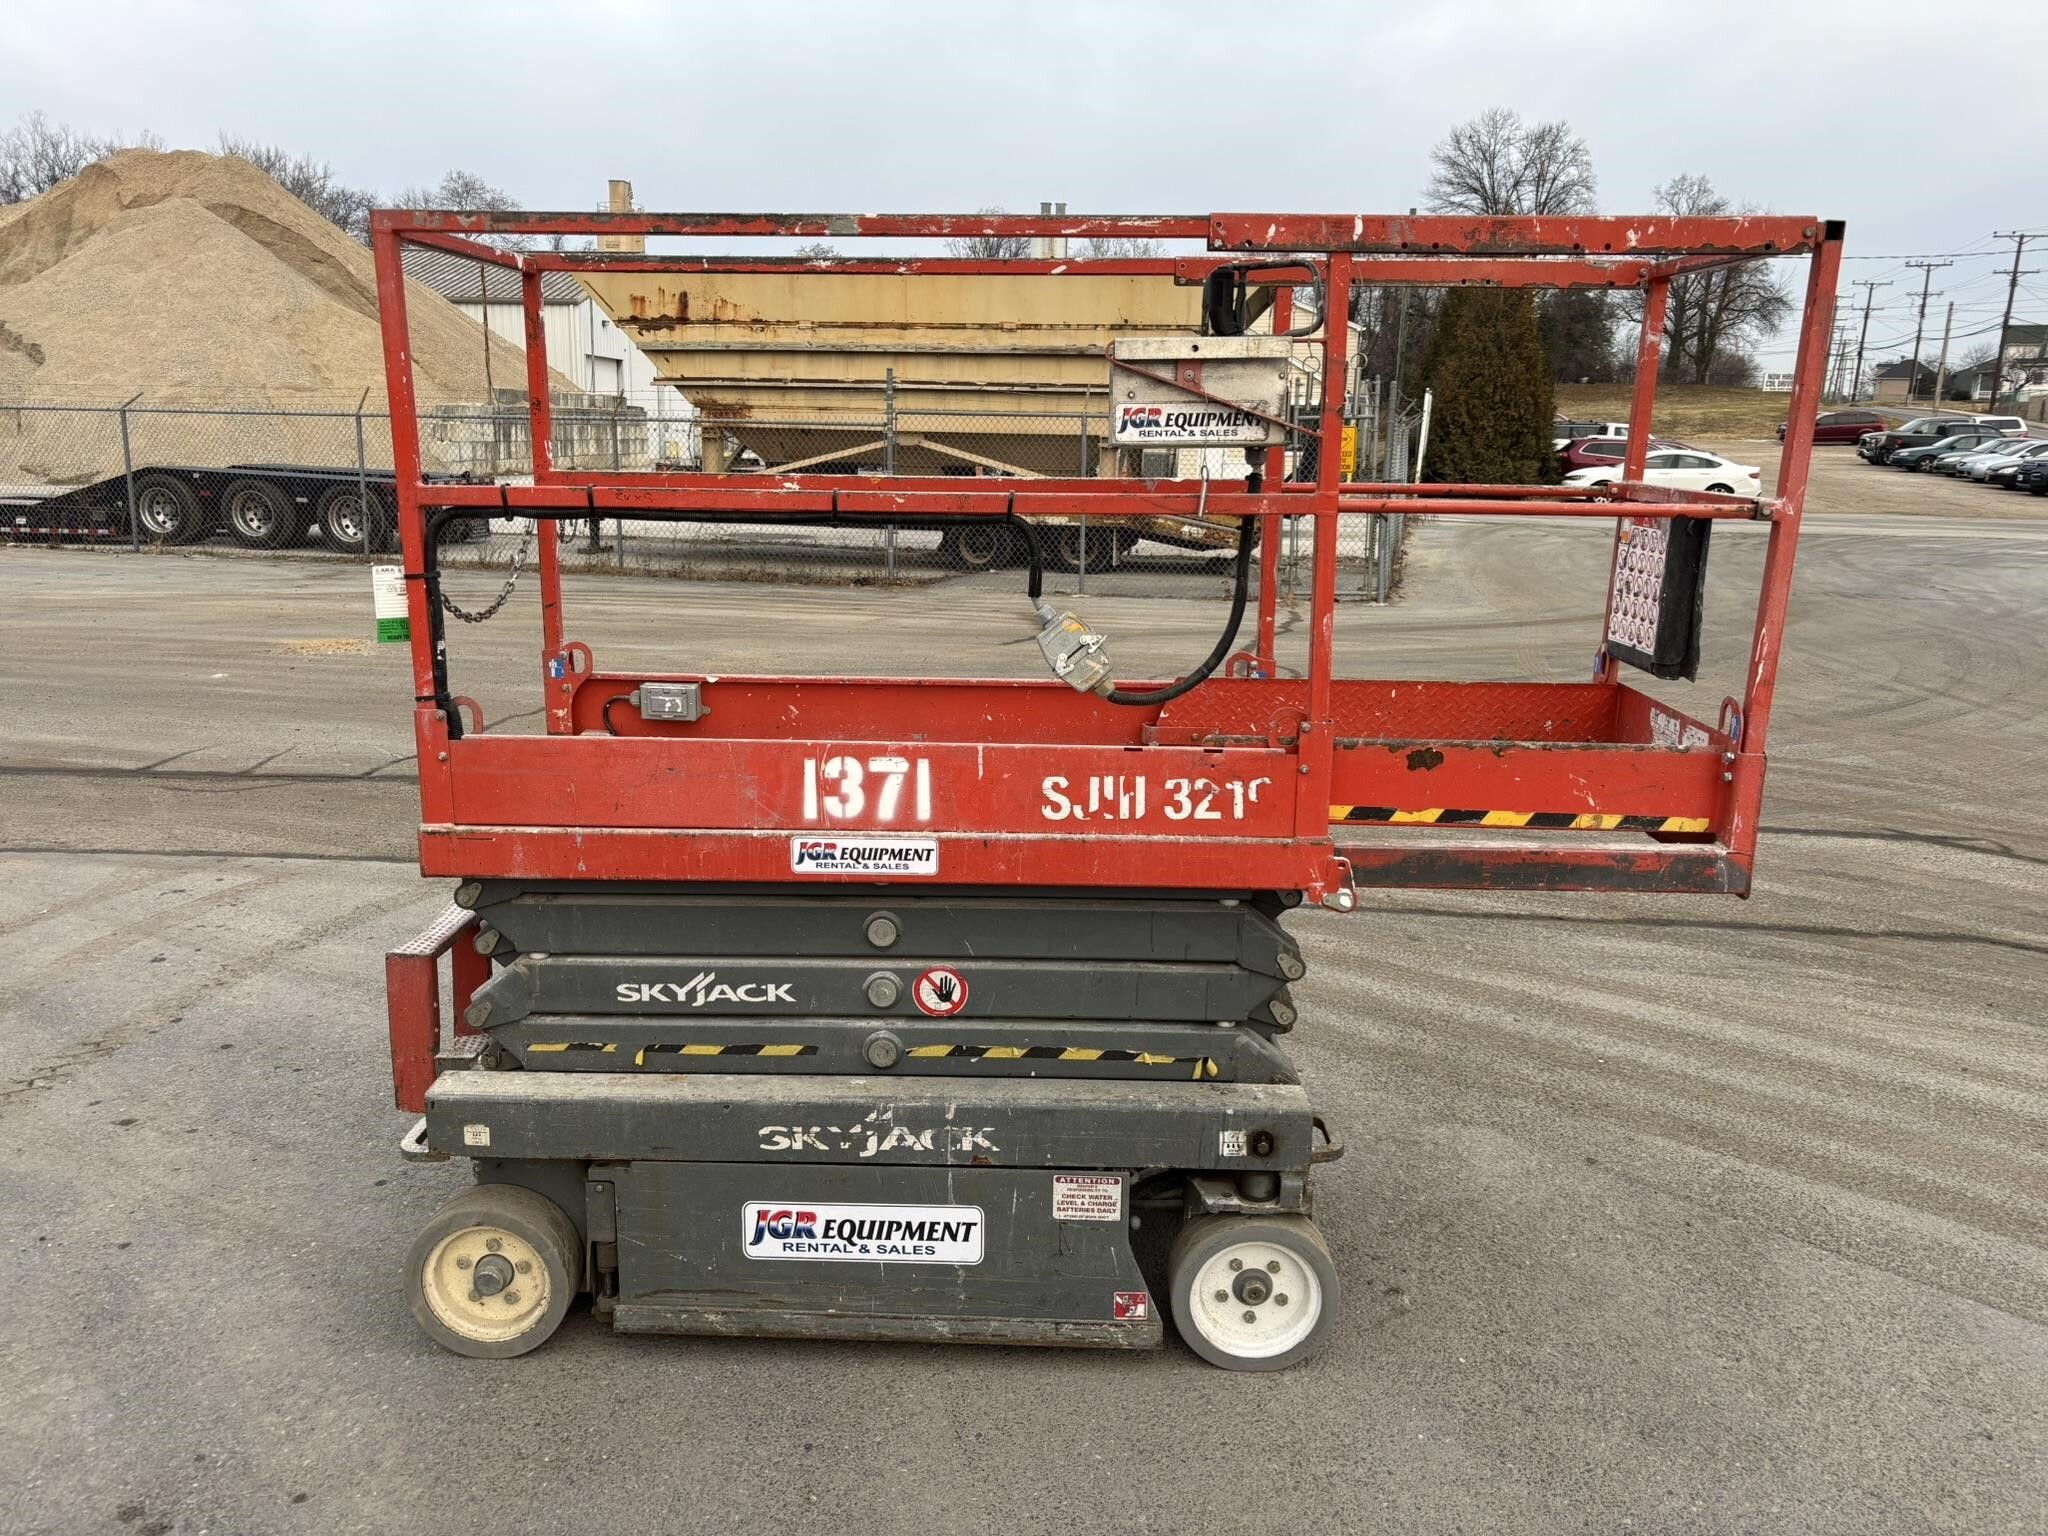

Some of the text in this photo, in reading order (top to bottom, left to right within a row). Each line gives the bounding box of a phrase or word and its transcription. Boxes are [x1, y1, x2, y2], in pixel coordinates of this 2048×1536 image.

[1117, 407, 1162, 434] JGR
[1200, 429, 1238, 437] SALES
[803, 756, 931, 822] 1371
[795, 841, 935, 866] JGR EQUIPMENT
[815, 862, 860, 870] RENTAL
[616, 971, 797, 1007] SKYJACK
[1059, 1177, 1115, 1185] ATTENTION
[750, 1209, 978, 1246] JGR EQUIPMENT
[782, 1242, 936, 1255] RENTAL & SALES
